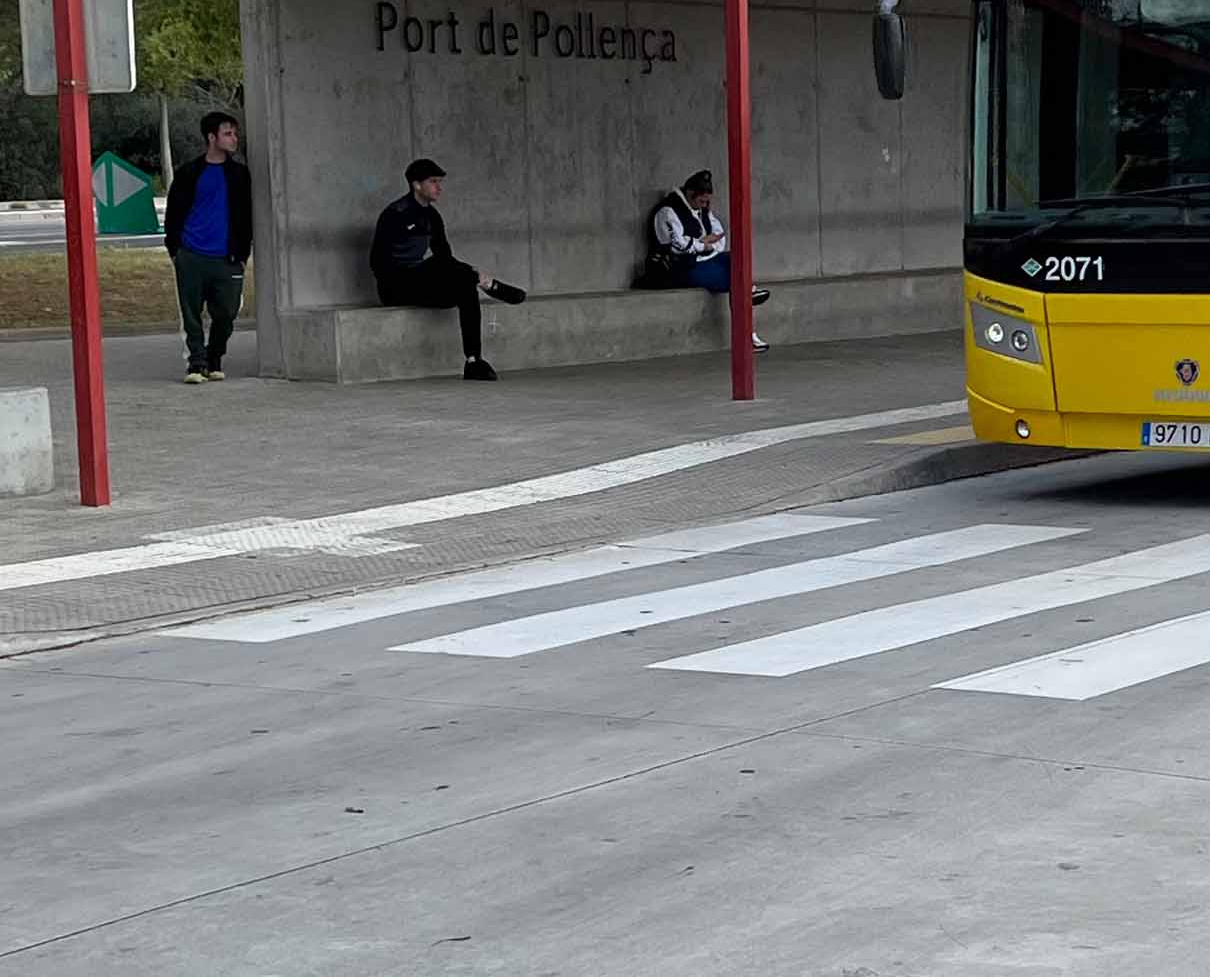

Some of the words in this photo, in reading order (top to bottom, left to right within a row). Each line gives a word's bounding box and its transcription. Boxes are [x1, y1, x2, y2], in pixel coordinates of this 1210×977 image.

[376, 0, 462, 54] Port
[479, 7, 519, 56] de
[532, 10, 678, 75] Pollença
[1045, 255, 1104, 281] 2071
[1155, 424, 1201, 444] 9710
